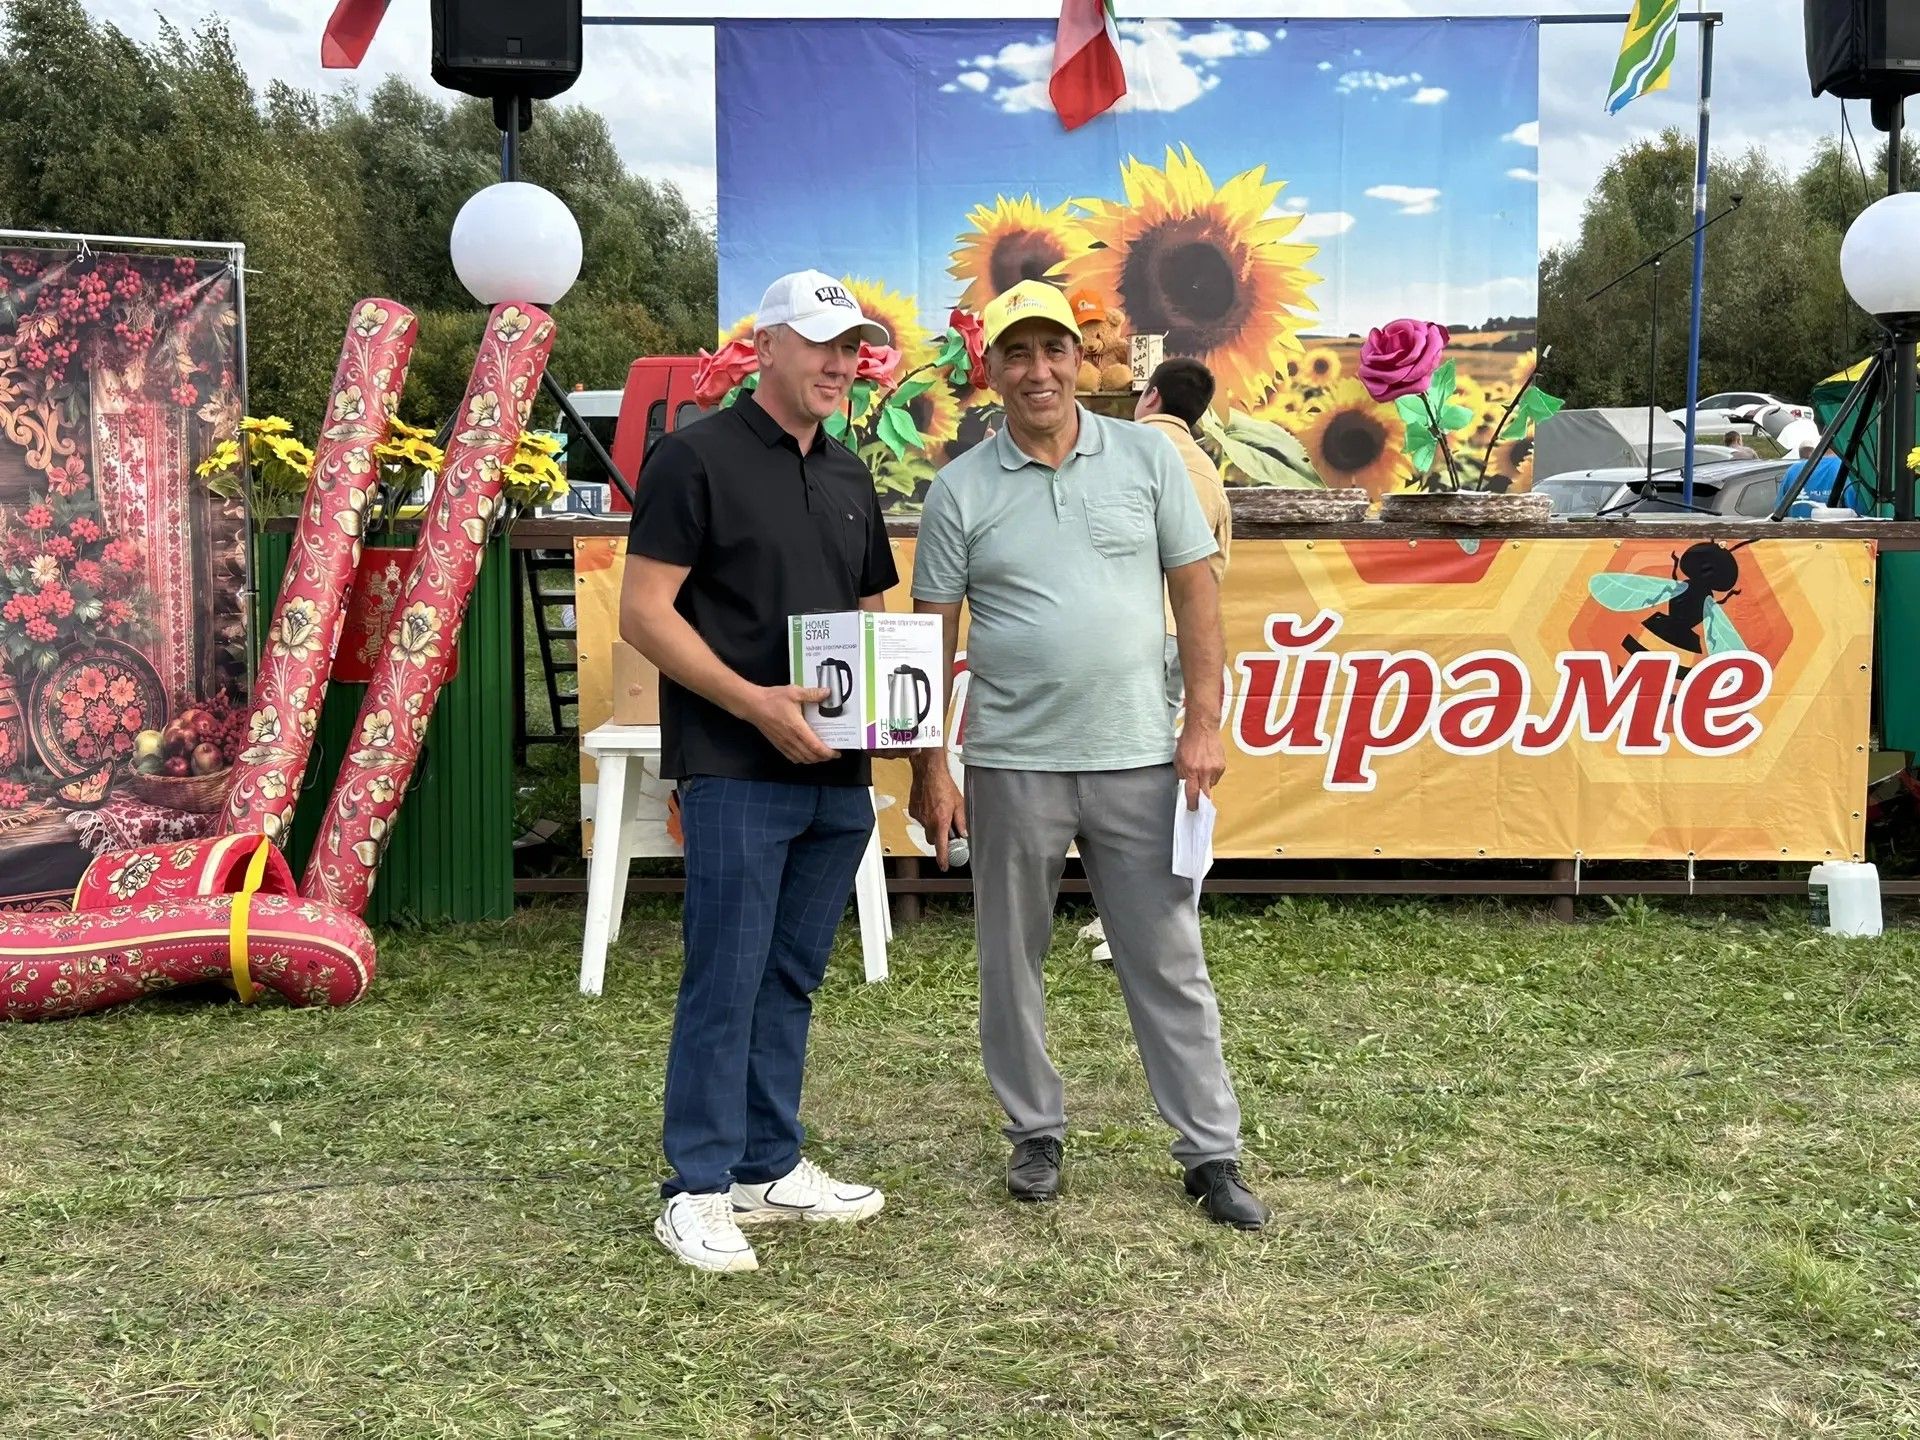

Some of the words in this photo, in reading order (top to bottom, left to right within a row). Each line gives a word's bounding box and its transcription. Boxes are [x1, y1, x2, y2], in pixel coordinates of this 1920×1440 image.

[805, 620, 830, 629] HOME
[805, 629, 830, 640] STAR
[1223, 612, 1772, 790] йрәме
[880, 718, 913, 730] HOME
[880, 731, 913, 747] STAR
